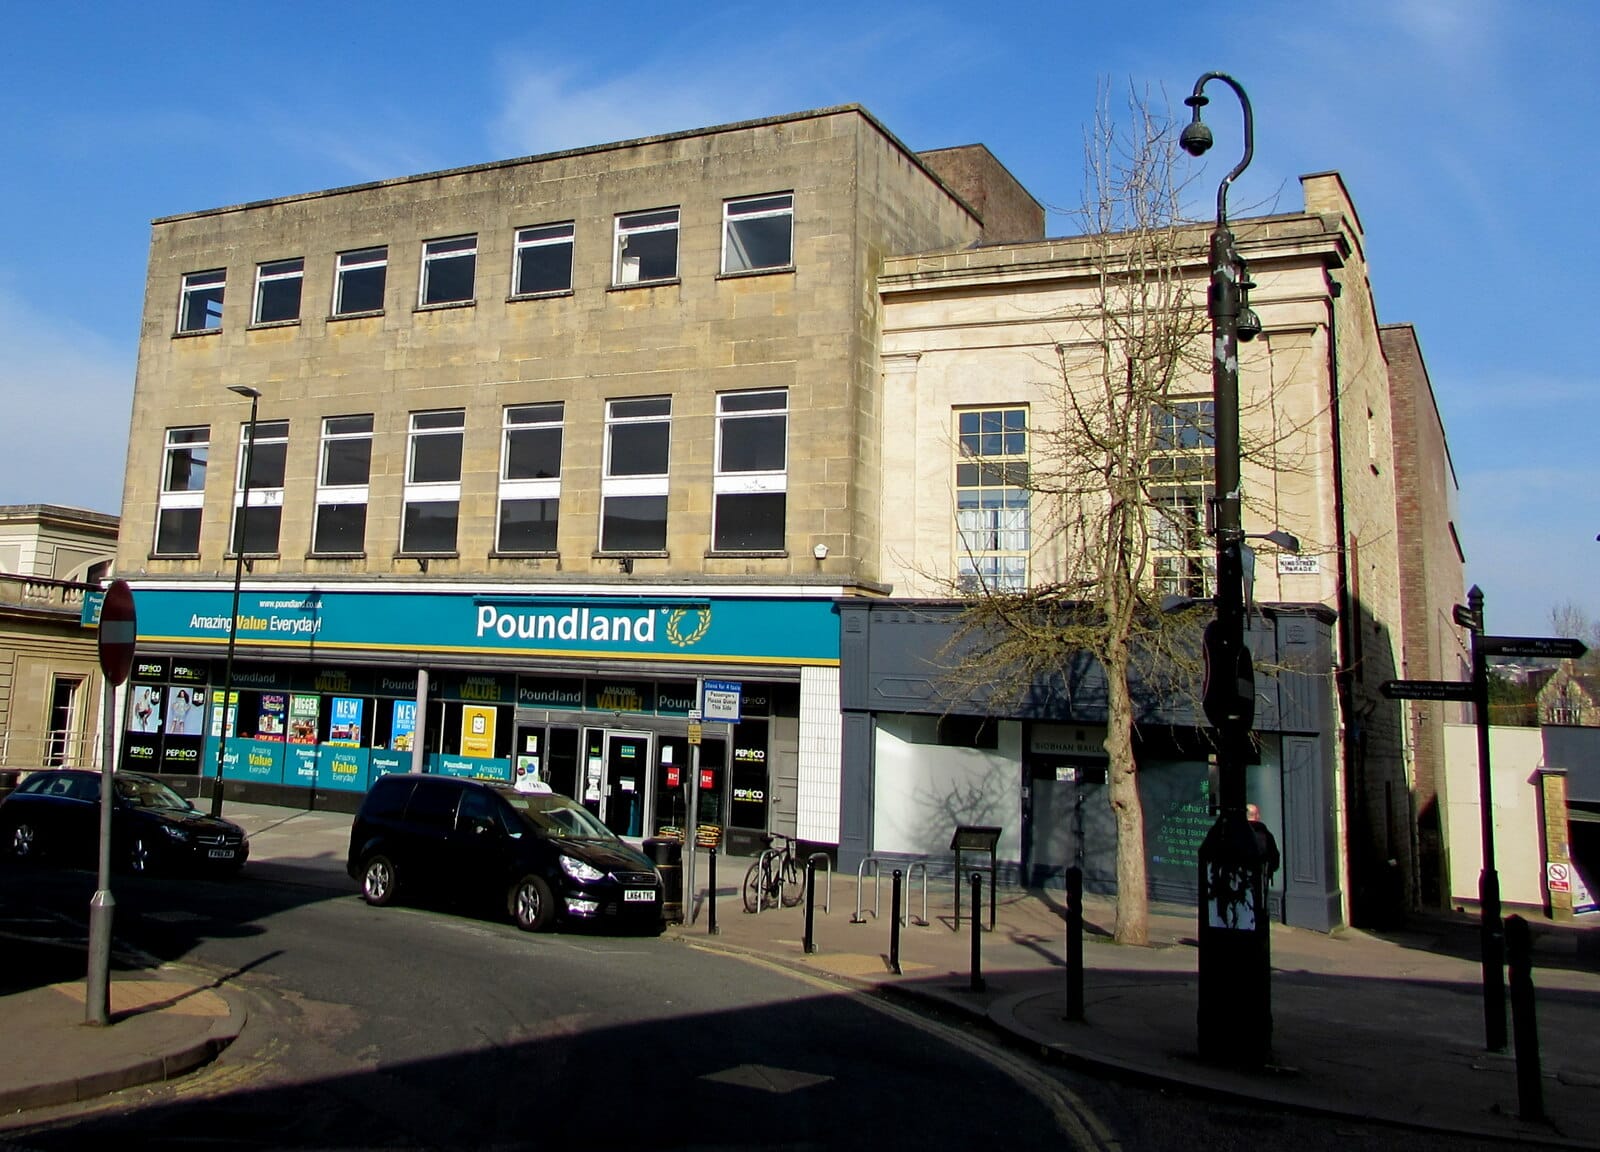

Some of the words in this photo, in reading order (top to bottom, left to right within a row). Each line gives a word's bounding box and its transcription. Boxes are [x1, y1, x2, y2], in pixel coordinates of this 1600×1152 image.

[259, 600, 323, 609] www.poundland.co.uk
[189, 614, 233, 632] Amazing
[235, 615, 268, 630] Value
[270, 616, 322, 634] Everyday!
[476, 605, 656, 641] Poundland
[231, 672, 276, 684] oundland
[459, 684, 501, 699] VALUE!
[519, 688, 583, 702] Poundland
[604, 686, 637, 695] AMAZING
[336, 700, 359, 713] NEW
[595, 694, 644, 710] VALUE!
[215, 751, 239, 764] Tday!
[296, 748, 322, 758] Poundland
[248, 753, 273, 767] Value
[303, 760, 314, 770] big
[373, 758, 399, 767] Poundland
[443, 760, 472, 770] Poundland
[331, 760, 358, 774] Value
[479, 765, 503, 775] Amazing
